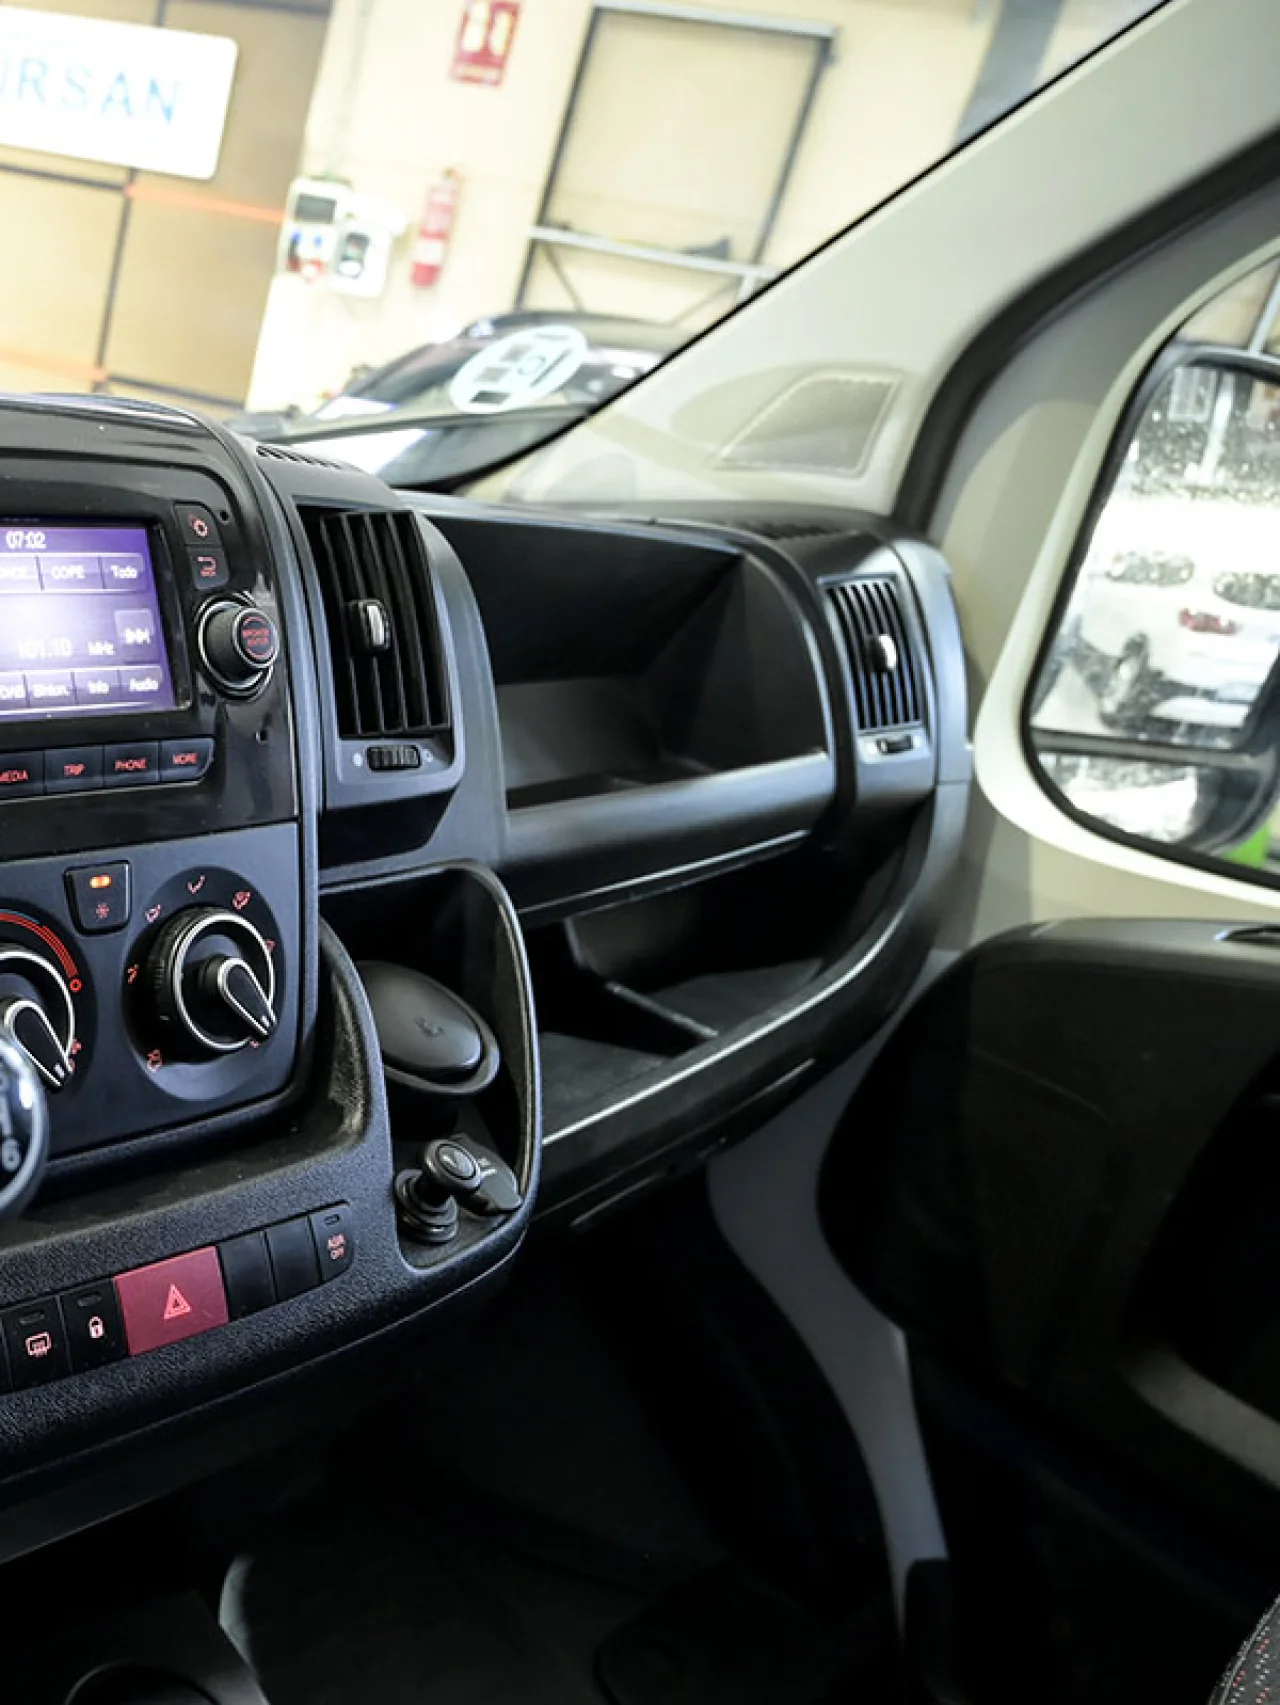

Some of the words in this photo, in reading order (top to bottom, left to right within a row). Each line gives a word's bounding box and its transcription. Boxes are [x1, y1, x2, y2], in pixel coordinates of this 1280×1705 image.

[5, 531, 47, 550] 07:02
[63, 763, 86, 777] TRIP
[114, 757, 148, 772] PHONE
